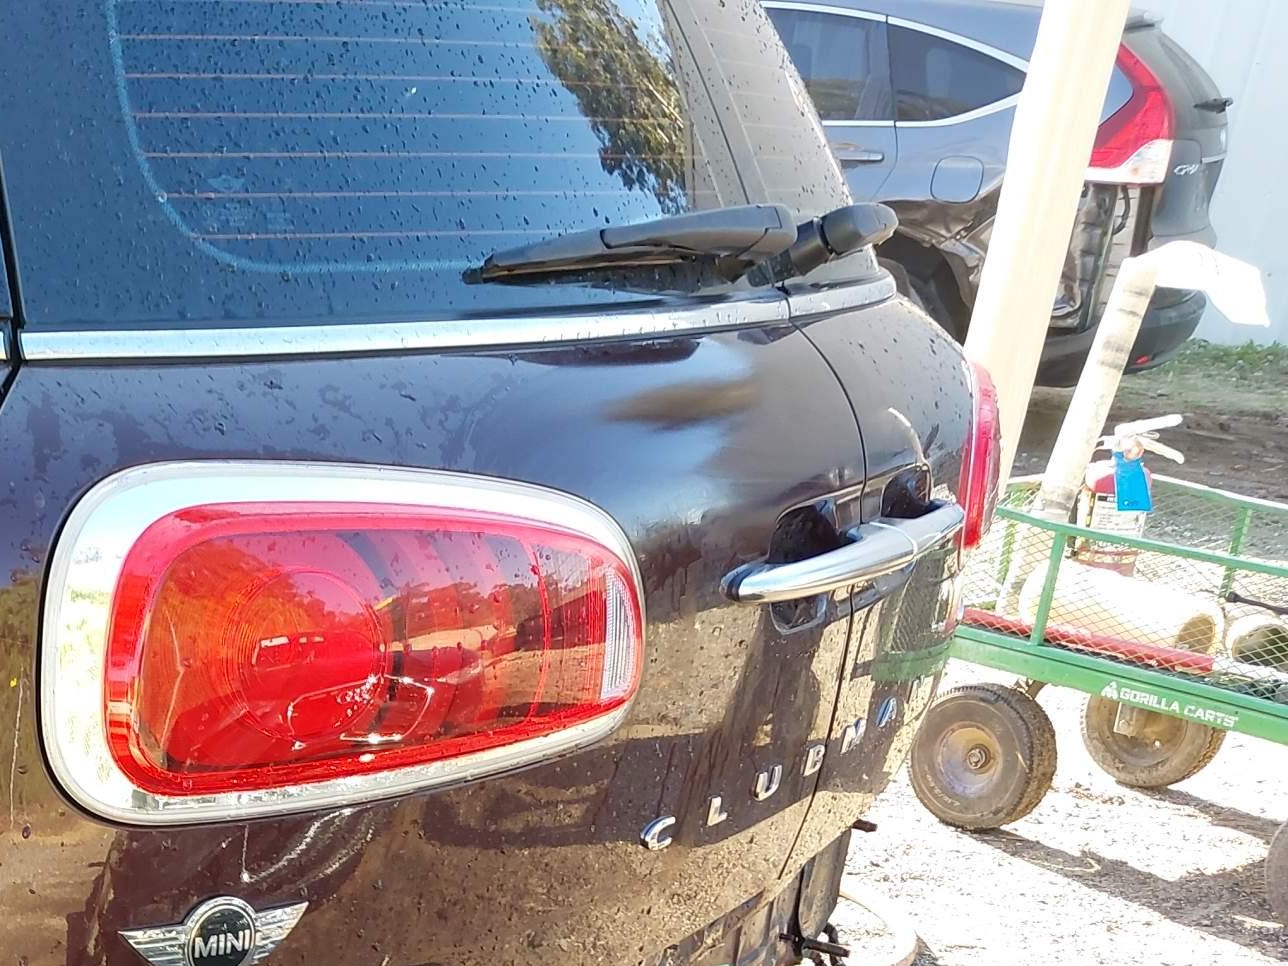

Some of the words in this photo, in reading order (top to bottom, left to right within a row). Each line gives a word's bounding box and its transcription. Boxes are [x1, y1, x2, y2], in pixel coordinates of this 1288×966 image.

[1119, 687, 1180, 714] GORILLA
[1183, 704, 1239, 728] CARTS
[194, 929, 251, 958] MINI
